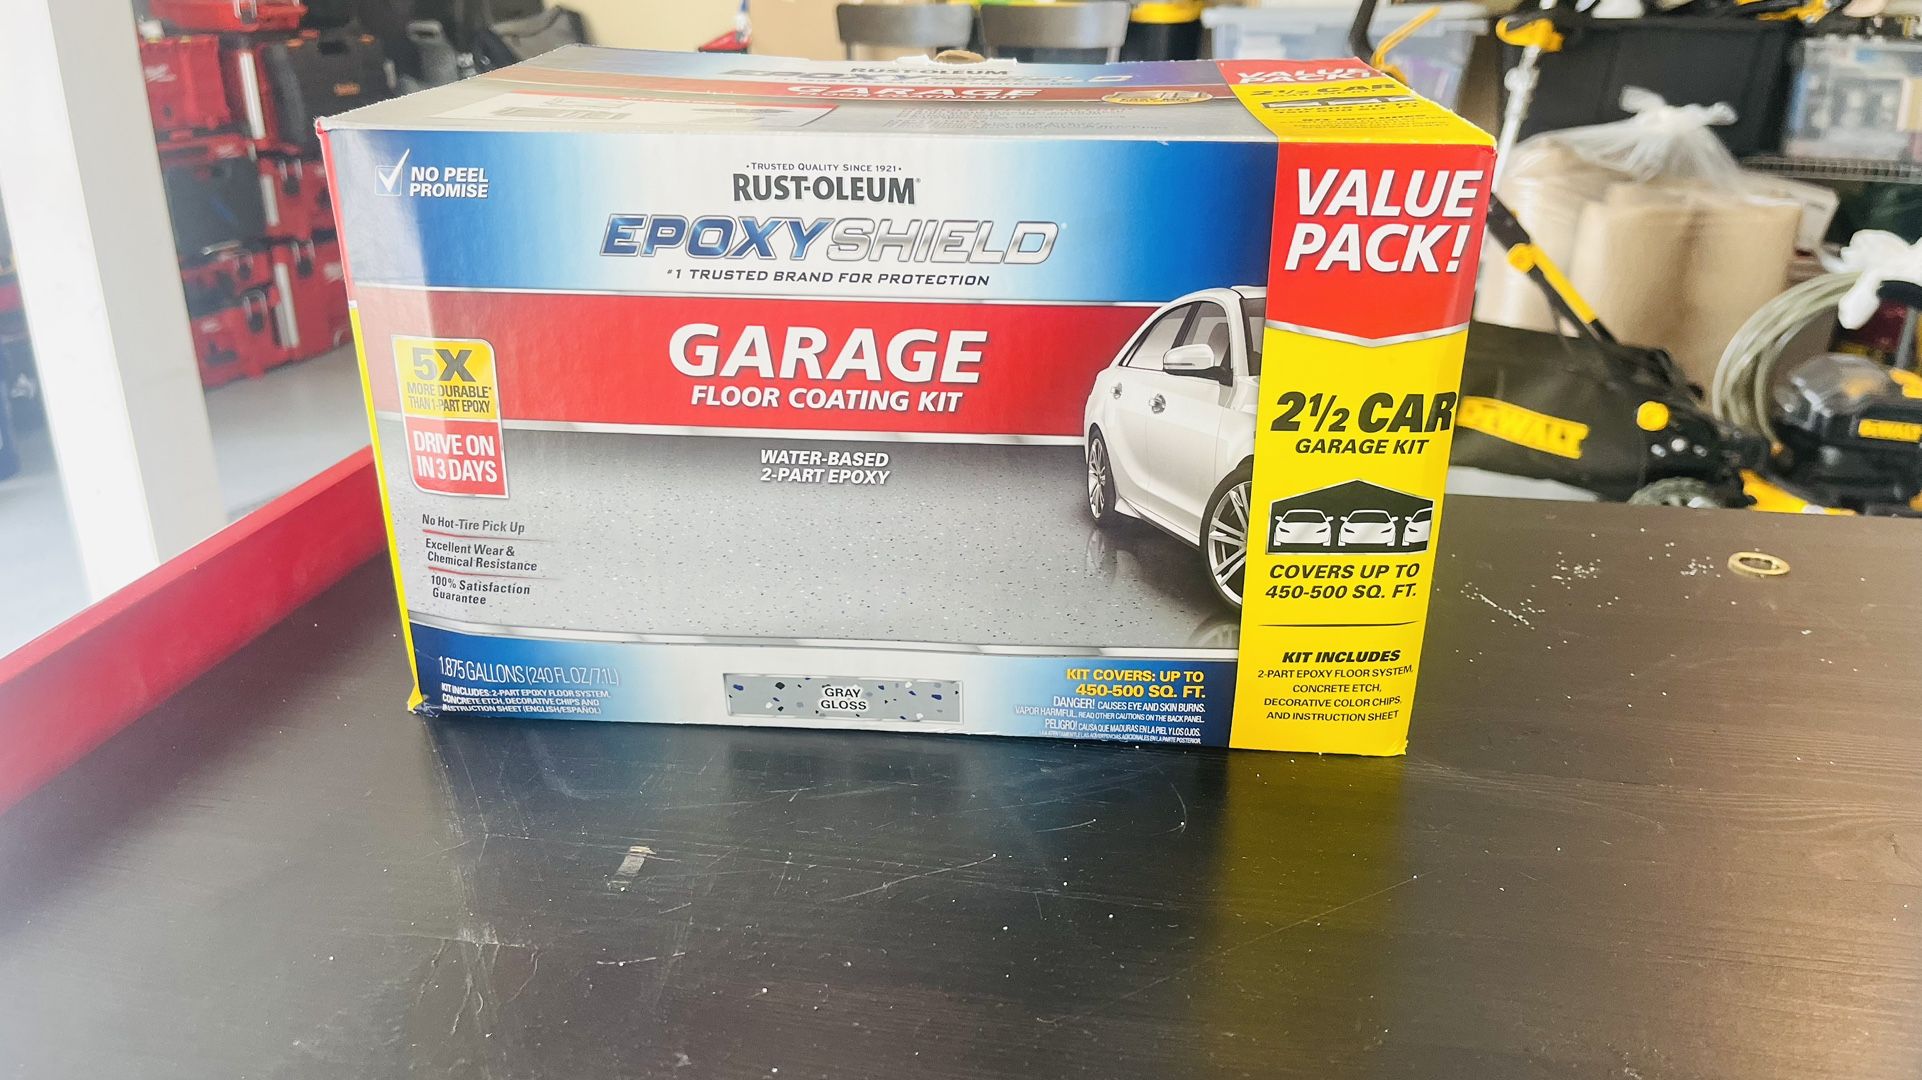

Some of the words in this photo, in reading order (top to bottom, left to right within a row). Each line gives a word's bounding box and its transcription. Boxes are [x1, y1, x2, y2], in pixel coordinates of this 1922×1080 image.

[787, 86, 1043, 96] GARAGE
[411, 166, 439, 182] NO
[444, 167, 489, 183] PEEL
[751, 162, 795, 171] TRUSTED
[798, 163, 838, 172] QUALITY
[842, 164, 872, 172] SINCE
[409, 183, 489, 198] PROMISE
[733, 173, 915, 205] RUST-OLEUM
[1298, 168, 1484, 218] VALUE
[599, 213, 1059, 265] EPOXYSHIELD
[1284, 223, 1470, 273] PACK!
[667, 269, 683, 281] #1
[689, 269, 769, 282] TRUSTED
[773, 271, 833, 284] BRAND
[838, 272, 873, 285] FOR
[877, 273, 990, 286] PROTECTION
[668, 322, 988, 385] GARAGE
[412, 347, 476, 383] 5X
[407, 382, 435, 395] MORE
[409, 396, 431, 410] THAN
[431, 398, 460, 411] 1-PART
[461, 400, 490, 413] EPOXY
[691, 384, 780, 408] FLOOR
[788, 386, 909, 412] COATING
[917, 390, 963, 413] KIT
[1358, 391, 1458, 433] CAR
[413, 431, 463, 455] DRIVE
[465, 435, 495, 457] ON
[1295, 438, 1390, 455] GARAGE
[1394, 439, 1429, 455] KIT
[760, 449, 889, 467] WATER-BASED
[417, 455, 435, 479] IN
[437, 457, 447, 480] 3
[448, 459, 498, 483] DAYS
[760, 468, 825, 483] 2-PART
[828, 470, 890, 485] EPOXY
[422, 514, 436, 525] No
[437, 516, 480, 530] Hot-Tire
[482, 520, 507, 532] Pick
[510, 522, 525, 535] Up
[425, 538, 471, 554] Excellent
[474, 544, 504, 556] Wear
[506, 546, 515, 557] &
[427, 551, 473, 567] Chemical
[476, 557, 538, 571] Resistance
[1269, 564, 1355, 579] COVERS
[1360, 564, 1389, 579] UP
[1395, 563, 1420, 579] TO
[431, 575, 456, 589] 100%
[460, 580, 531, 594] Satisfaction
[1265, 585, 1347, 599] 450-500
[1352, 584, 1385, 599] SQ.
[1392, 583, 1416, 598] FT.
[433, 588, 487, 605] Guarantee
[1282, 652, 1313, 663] KIT
[1315, 650, 1401, 663] INCLUDES
[439, 655, 466, 680] 1.875
[466, 660, 525, 684] GALLONS
[526, 666, 551, 686] (240
[1067, 668, 1090, 681] KIT
[1093, 669, 1155, 682] COVERS:
[1159, 670, 1181, 682] UP
[1183, 671, 1205, 683] TO
[1258, 669, 1295, 678] 2-PART
[1297, 669, 1332, 678] EPOXY
[1334, 669, 1370, 677] FLOOR
[441, 682, 451, 692] KIT
[452, 685, 492, 697] INCLUDES:
[492, 689, 520, 697] 2-PART
[521, 689, 547, 697] EPOXY
[548, 689, 575, 697] FLOOR
[824, 687, 862, 698] GRAY
[1076, 684, 1144, 697] 450-500
[1148, 685, 1177, 698] SQ.
[1182, 686, 1206, 698] FT.
[1293, 684, 1350, 692] CONCRETE
[1352, 683, 1381, 693] ETCH,
[442, 693, 481, 705] CONCRETE
[505, 697, 556, 705] DECORATIVE
[556, 698, 580, 706] CHIPS
[442, 704, 496, 712] INSTRUCTION
[820, 700, 867, 710] GLOSS
[1053, 696, 1095, 709] DANGER!
[1097, 701, 1127, 711] CAUSES
[1128, 702, 1142, 711] EYE
[1142, 703, 1159, 711] AND
[1160, 703, 1177, 712] SKIN
[1178, 703, 1205, 712] BURNS.
[1264, 698, 1331, 707] DECORATIVE
[1334, 698, 1370, 707] COLOR
[1015, 705, 1039, 715] VAPOR
[1095, 712, 1115, 720] OTHER
[1115, 713, 1145, 721] CAUTIONS
[1155, 714, 1167, 722] THE
[1266, 711, 1291, 720] AND
[1292, 712, 1366, 721] INSTRUCTION
[1368, 710, 1399, 721] SHEET
[1045, 719, 1078, 730] PELIGRO!
